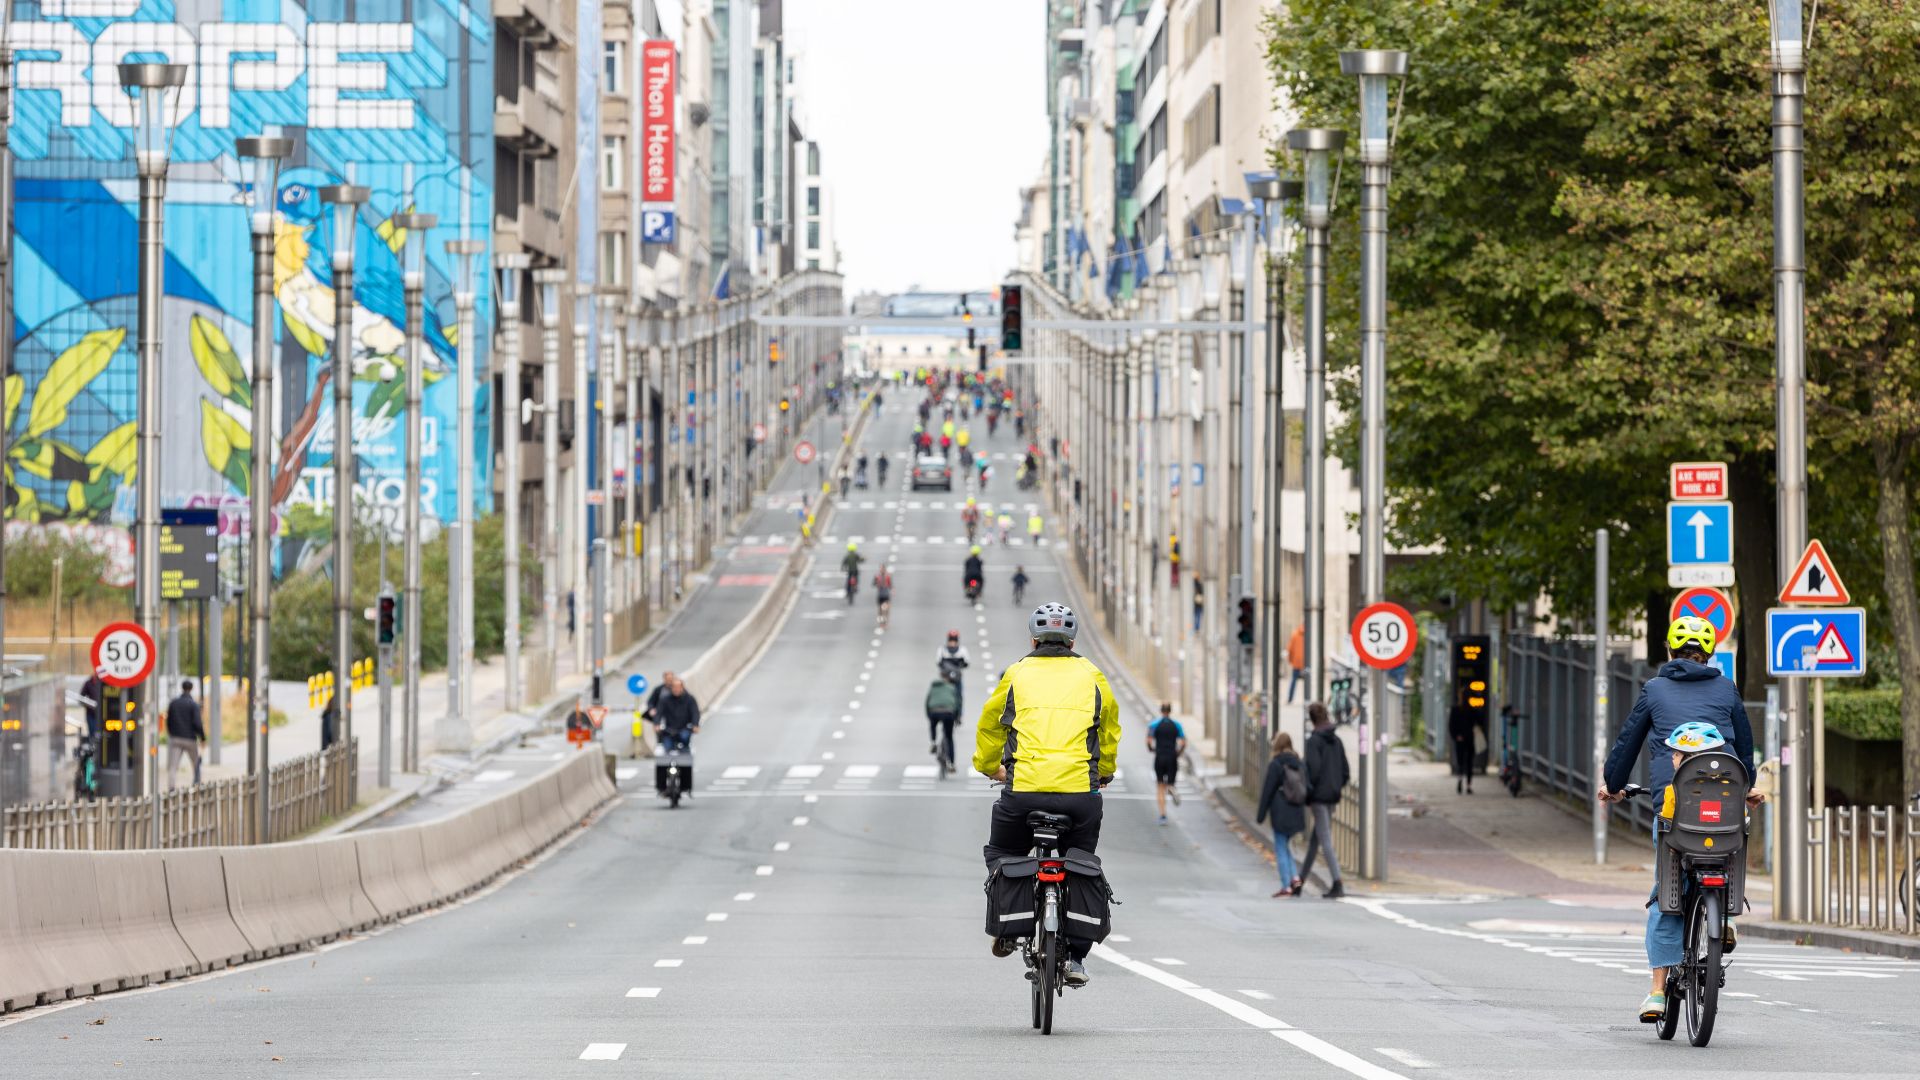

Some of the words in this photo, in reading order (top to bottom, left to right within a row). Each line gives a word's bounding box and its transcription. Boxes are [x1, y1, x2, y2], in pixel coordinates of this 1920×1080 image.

[648, 61, 669, 118] Thon
[648, 124, 669, 194] Hotels
[644, 212, 666, 237] P
[1368, 622, 1400, 642] 50
[107, 641, 139, 661] 50
[1376, 646, 1394, 655] km
[114, 664, 132, 673] km
